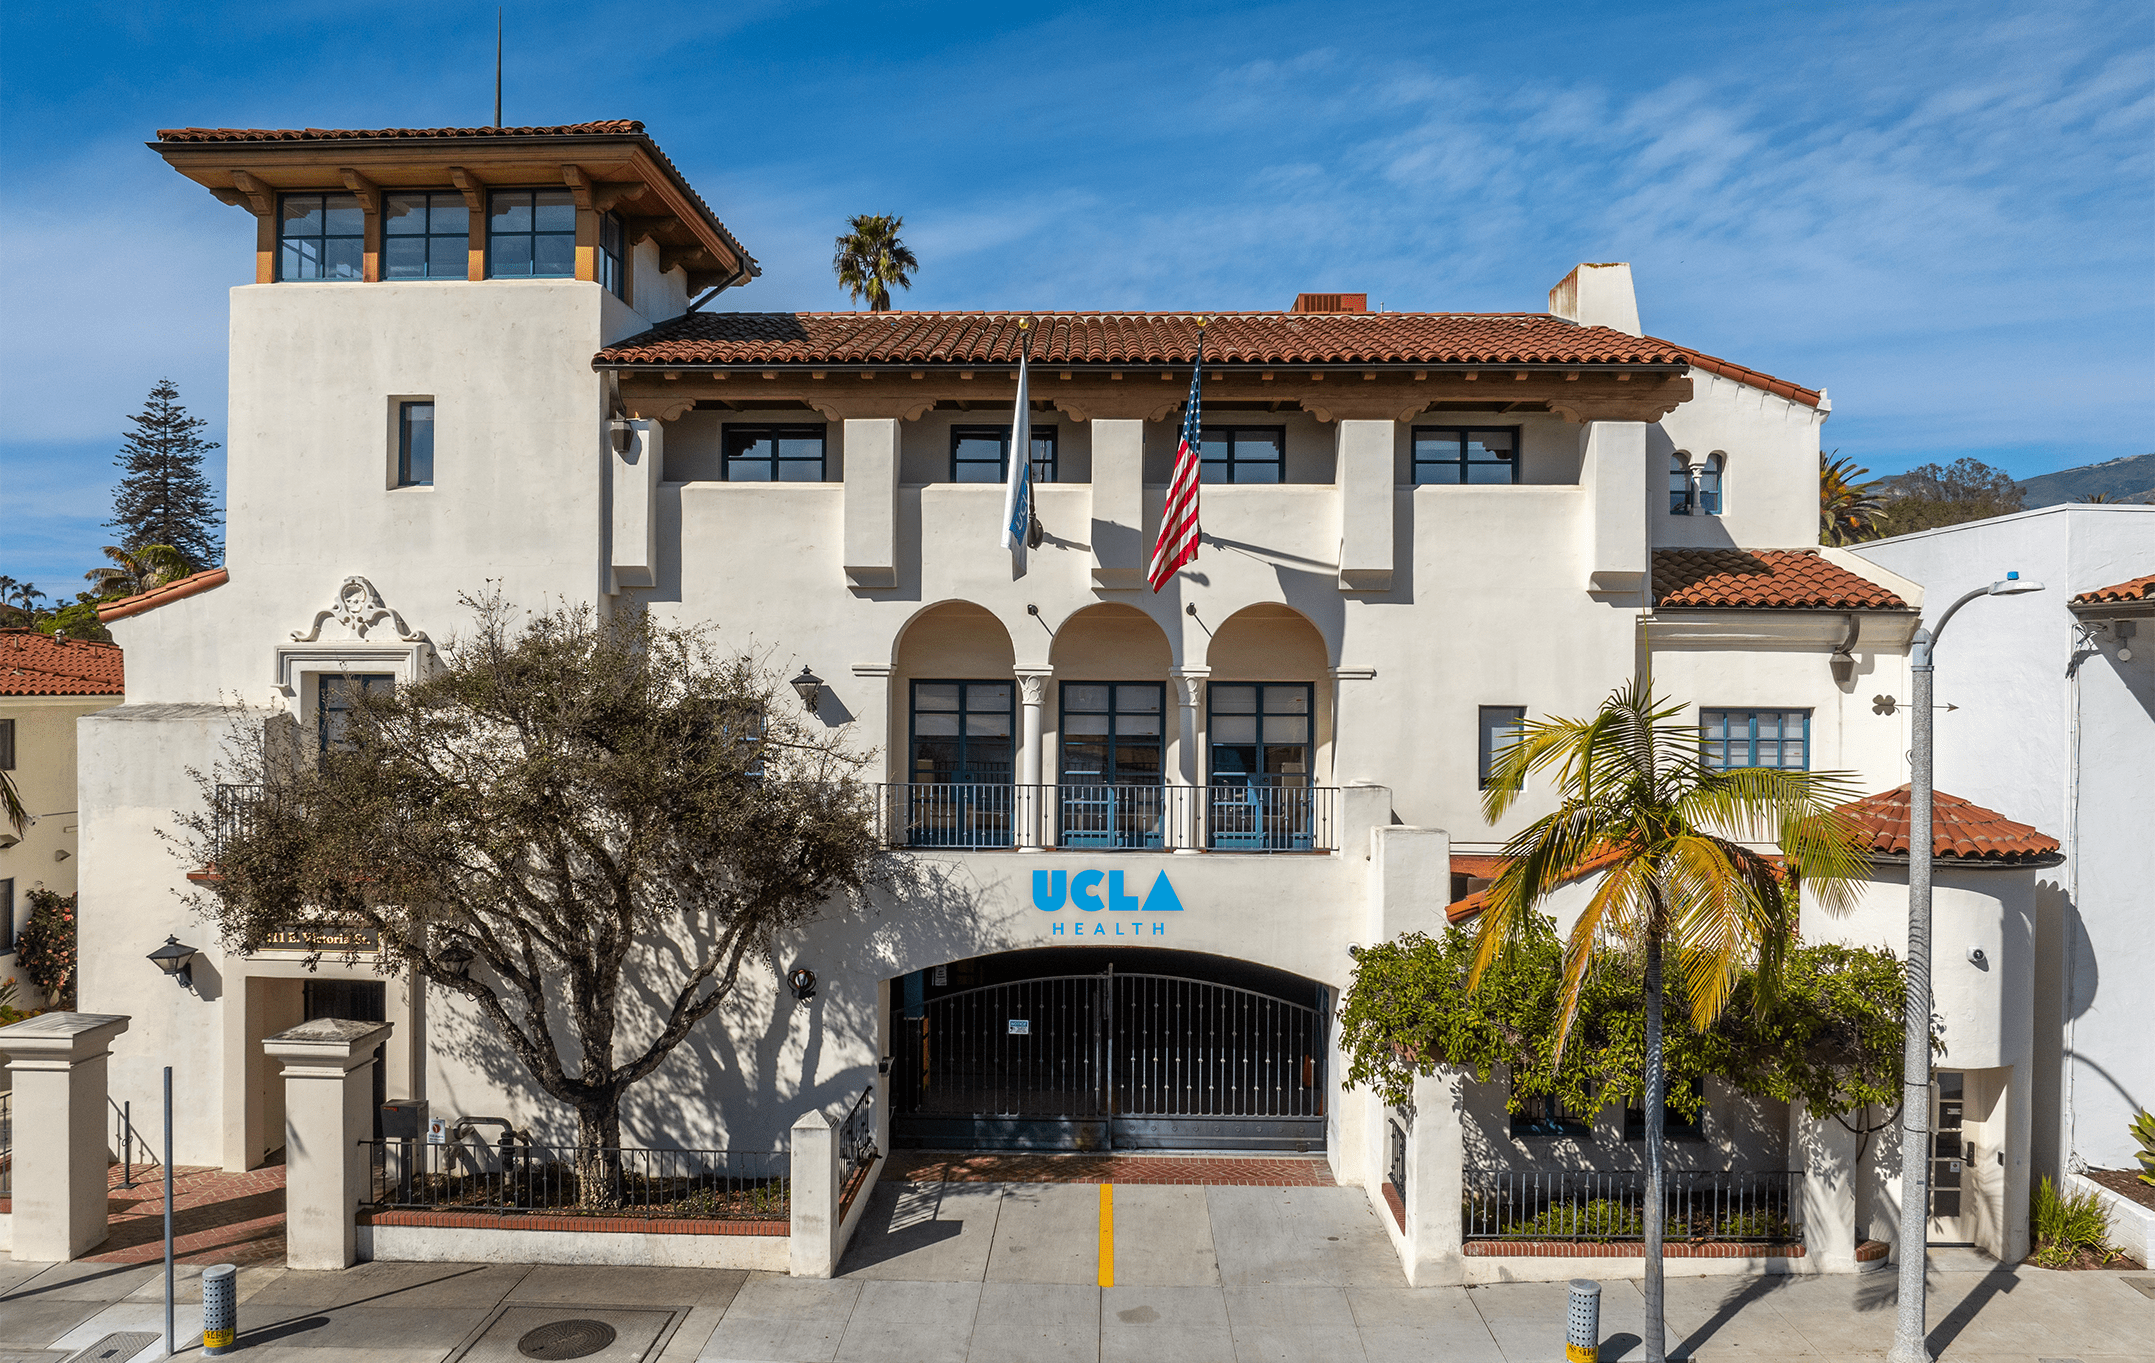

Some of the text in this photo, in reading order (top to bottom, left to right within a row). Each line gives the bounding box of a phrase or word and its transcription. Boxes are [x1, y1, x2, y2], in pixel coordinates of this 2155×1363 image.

[1032, 868, 1184, 912] UCLA
[1052, 922, 1165, 936] HEALTH
[302, 932, 350, 944] Victoria
